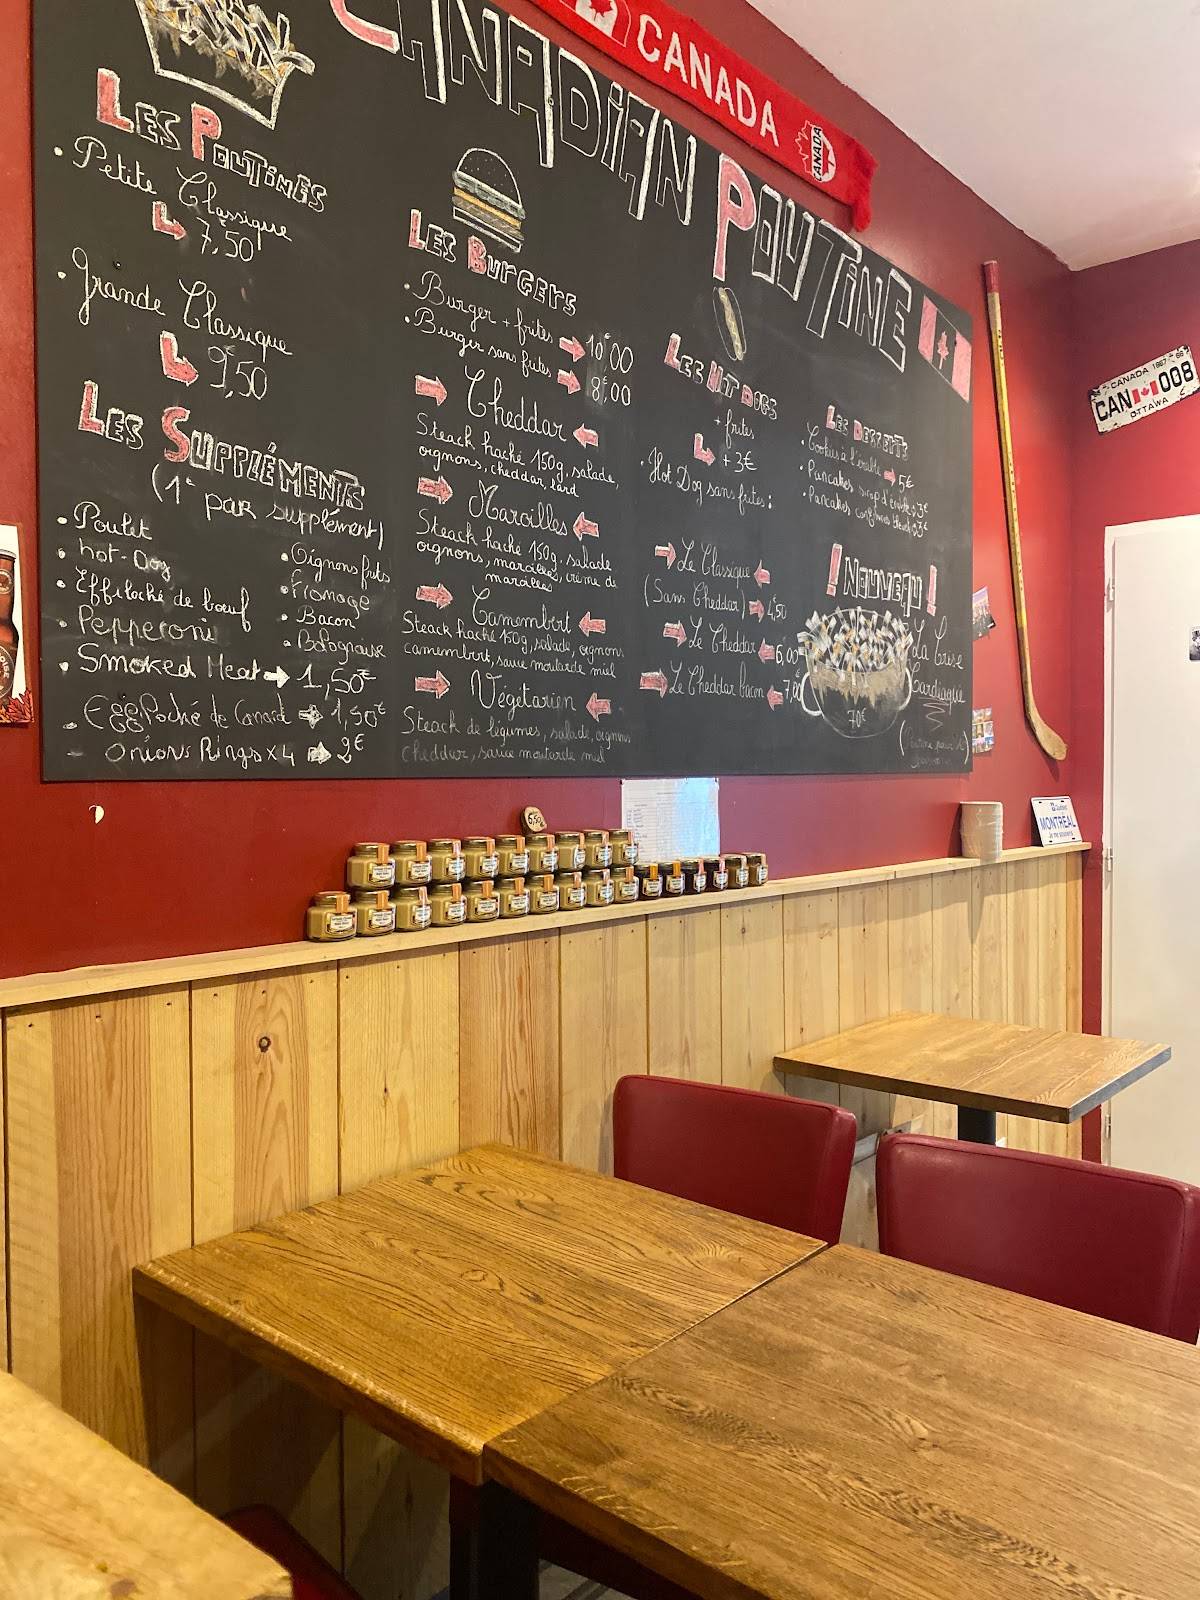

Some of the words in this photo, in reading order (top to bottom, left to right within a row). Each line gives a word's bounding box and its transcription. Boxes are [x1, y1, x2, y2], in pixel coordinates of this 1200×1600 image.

[637, 13, 779, 147] CANADA
[96, 67, 182, 150] LES
[812, 126, 823, 182] CANADA
[72, 135, 157, 195] Petite
[176, 166, 292, 251] Classique
[196, 216, 254, 262] 7,50
[408, 208, 457, 263] LES
[72, 247, 166, 325] Grande
[179, 278, 293, 362] Classique
[411, 270, 497, 332] Burger
[514, 307, 553, 346] frites
[413, 306, 485, 358] Burger
[487, 345, 517, 364] sans
[520, 349, 552, 378] frites
[664, 333, 705, 384] LES
[1095, 388, 1133, 422] CAN
[1158, 360, 1194, 393] 008
[1110, 367, 1149, 389] CANADA
[465, 365, 567, 442] Cheddar
[825, 404, 849, 437] LES
[1130, 396, 1169, 418] OTTAWA
[78, 379, 144, 449] LES
[161, 406, 366, 511] SUPPLÉMENTS
[416, 412, 476, 450] Steack
[481, 430, 525, 466] haché
[724, 408, 755, 449] frites
[647, 446, 673, 484] Hot
[676, 465, 703, 507] Dog
[705, 481, 736, 500] sans
[733, 450, 758, 473] 3€
[807, 459, 854, 493] Pancakes
[549, 479, 580, 498] lard
[808, 484, 851, 516] Pancakes
[898, 474, 915, 494] 5€
[73, 500, 153, 541] Poulet
[205, 492, 257, 521] par
[468, 479, 568, 537] Maroilles
[416, 508, 479, 546] Steack
[481, 526, 522, 556] haché
[565, 545, 613, 572] salade
[290, 541, 359, 583] Oignons
[676, 536, 697, 573] Le
[700, 543, 751, 589] Classique
[75, 565, 165, 607] Effiloché
[173, 588, 194, 609] de
[290, 568, 370, 620] Fromage
[843, 556, 923, 618] NOUVEAU
[78, 603, 217, 646] Pepperoni
[295, 604, 357, 630] Bacon
[400, 609, 453, 638] Steack
[455, 617, 498, 643] haché
[471, 584, 573, 635] Camembert
[297, 627, 387, 665] Bolognaise
[688, 615, 704, 650] Le
[708, 622, 757, 655] Cheddar
[77, 642, 197, 679] Smoked
[207, 652, 261, 681] Meat
[530, 655, 586, 676] moutarde
[590, 665, 617, 679] miel
[668, 659, 685, 695] Le
[688, 664, 738, 696] Cheddar
[738, 660, 765, 699] bacon
[83, 694, 144, 733] Egg
[138, 692, 201, 727] Poché
[210, 693, 229, 730] de
[234, 692, 292, 726] Canard
[470, 669, 577, 721] Végétarien
[400, 705, 461, 735] Steack
[466, 718, 481, 736] de
[104, 736, 194, 763] Onions
[199, 735, 263, 769] Rings
[340, 733, 366, 764] 2€
